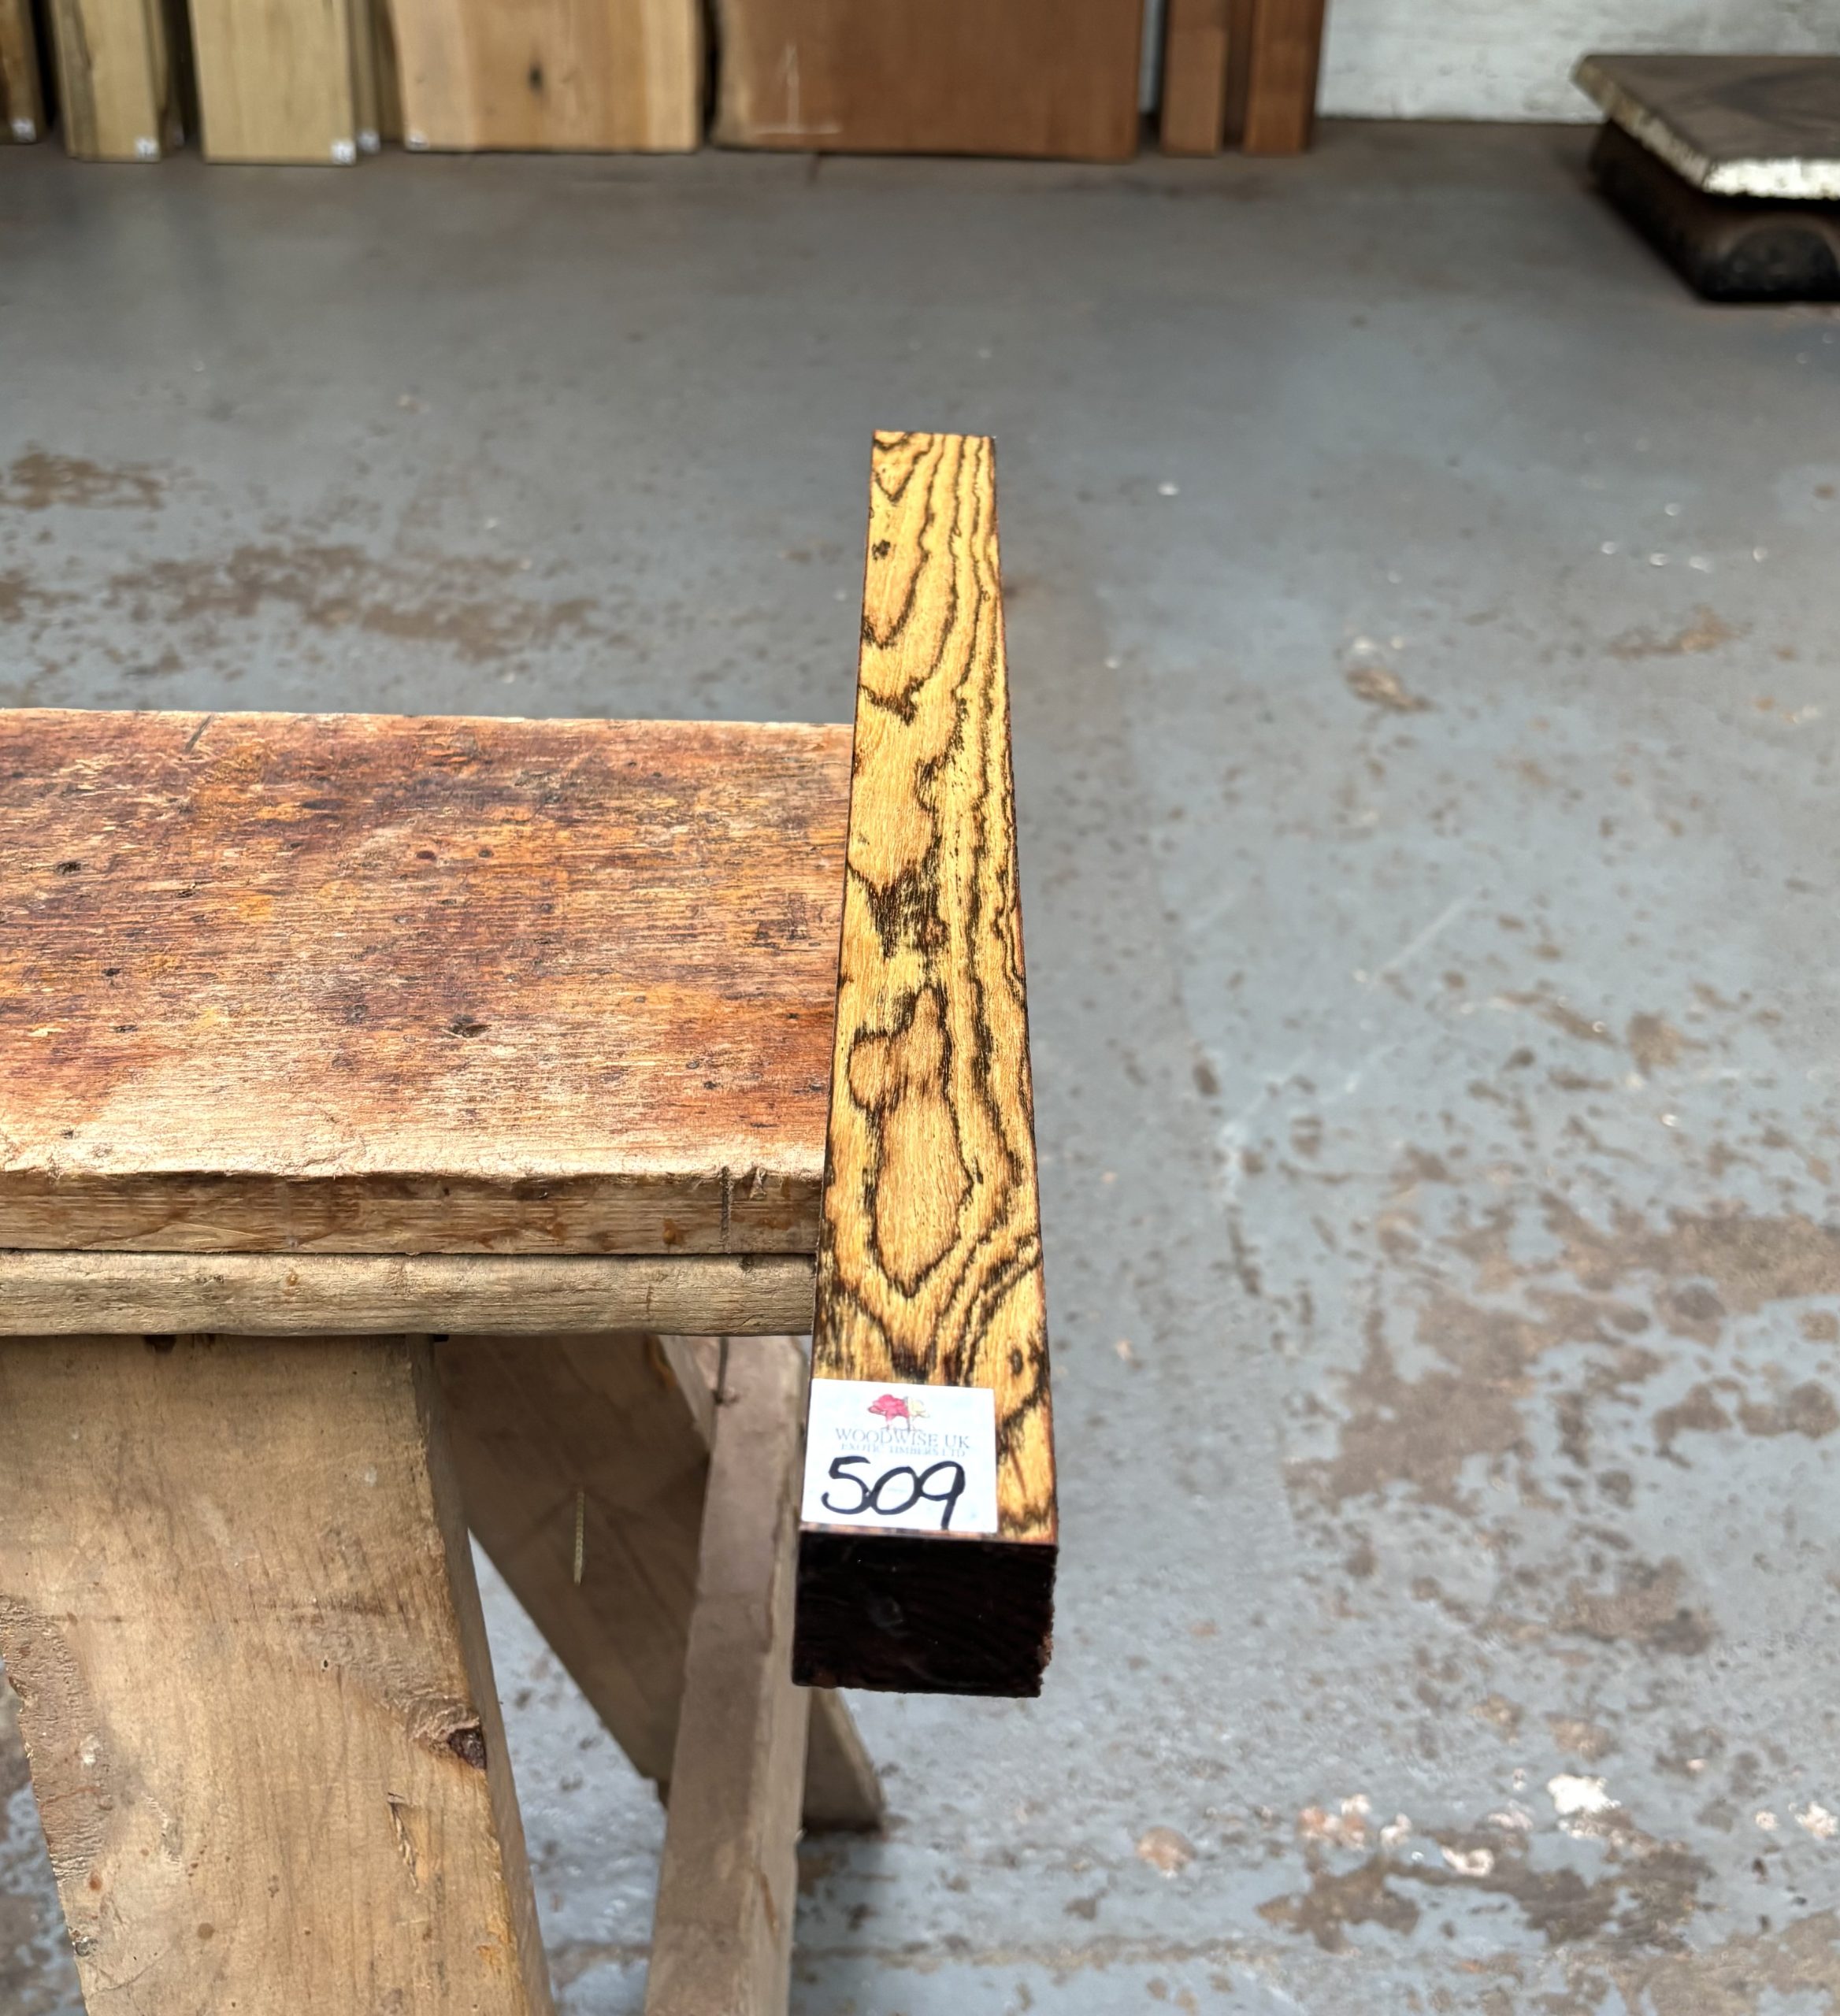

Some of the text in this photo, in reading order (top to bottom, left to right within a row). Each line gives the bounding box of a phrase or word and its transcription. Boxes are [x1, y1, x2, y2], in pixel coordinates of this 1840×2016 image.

[835, 1427, 970, 1449] WOODWISE UK
[821, 1455, 966, 1530] 509
